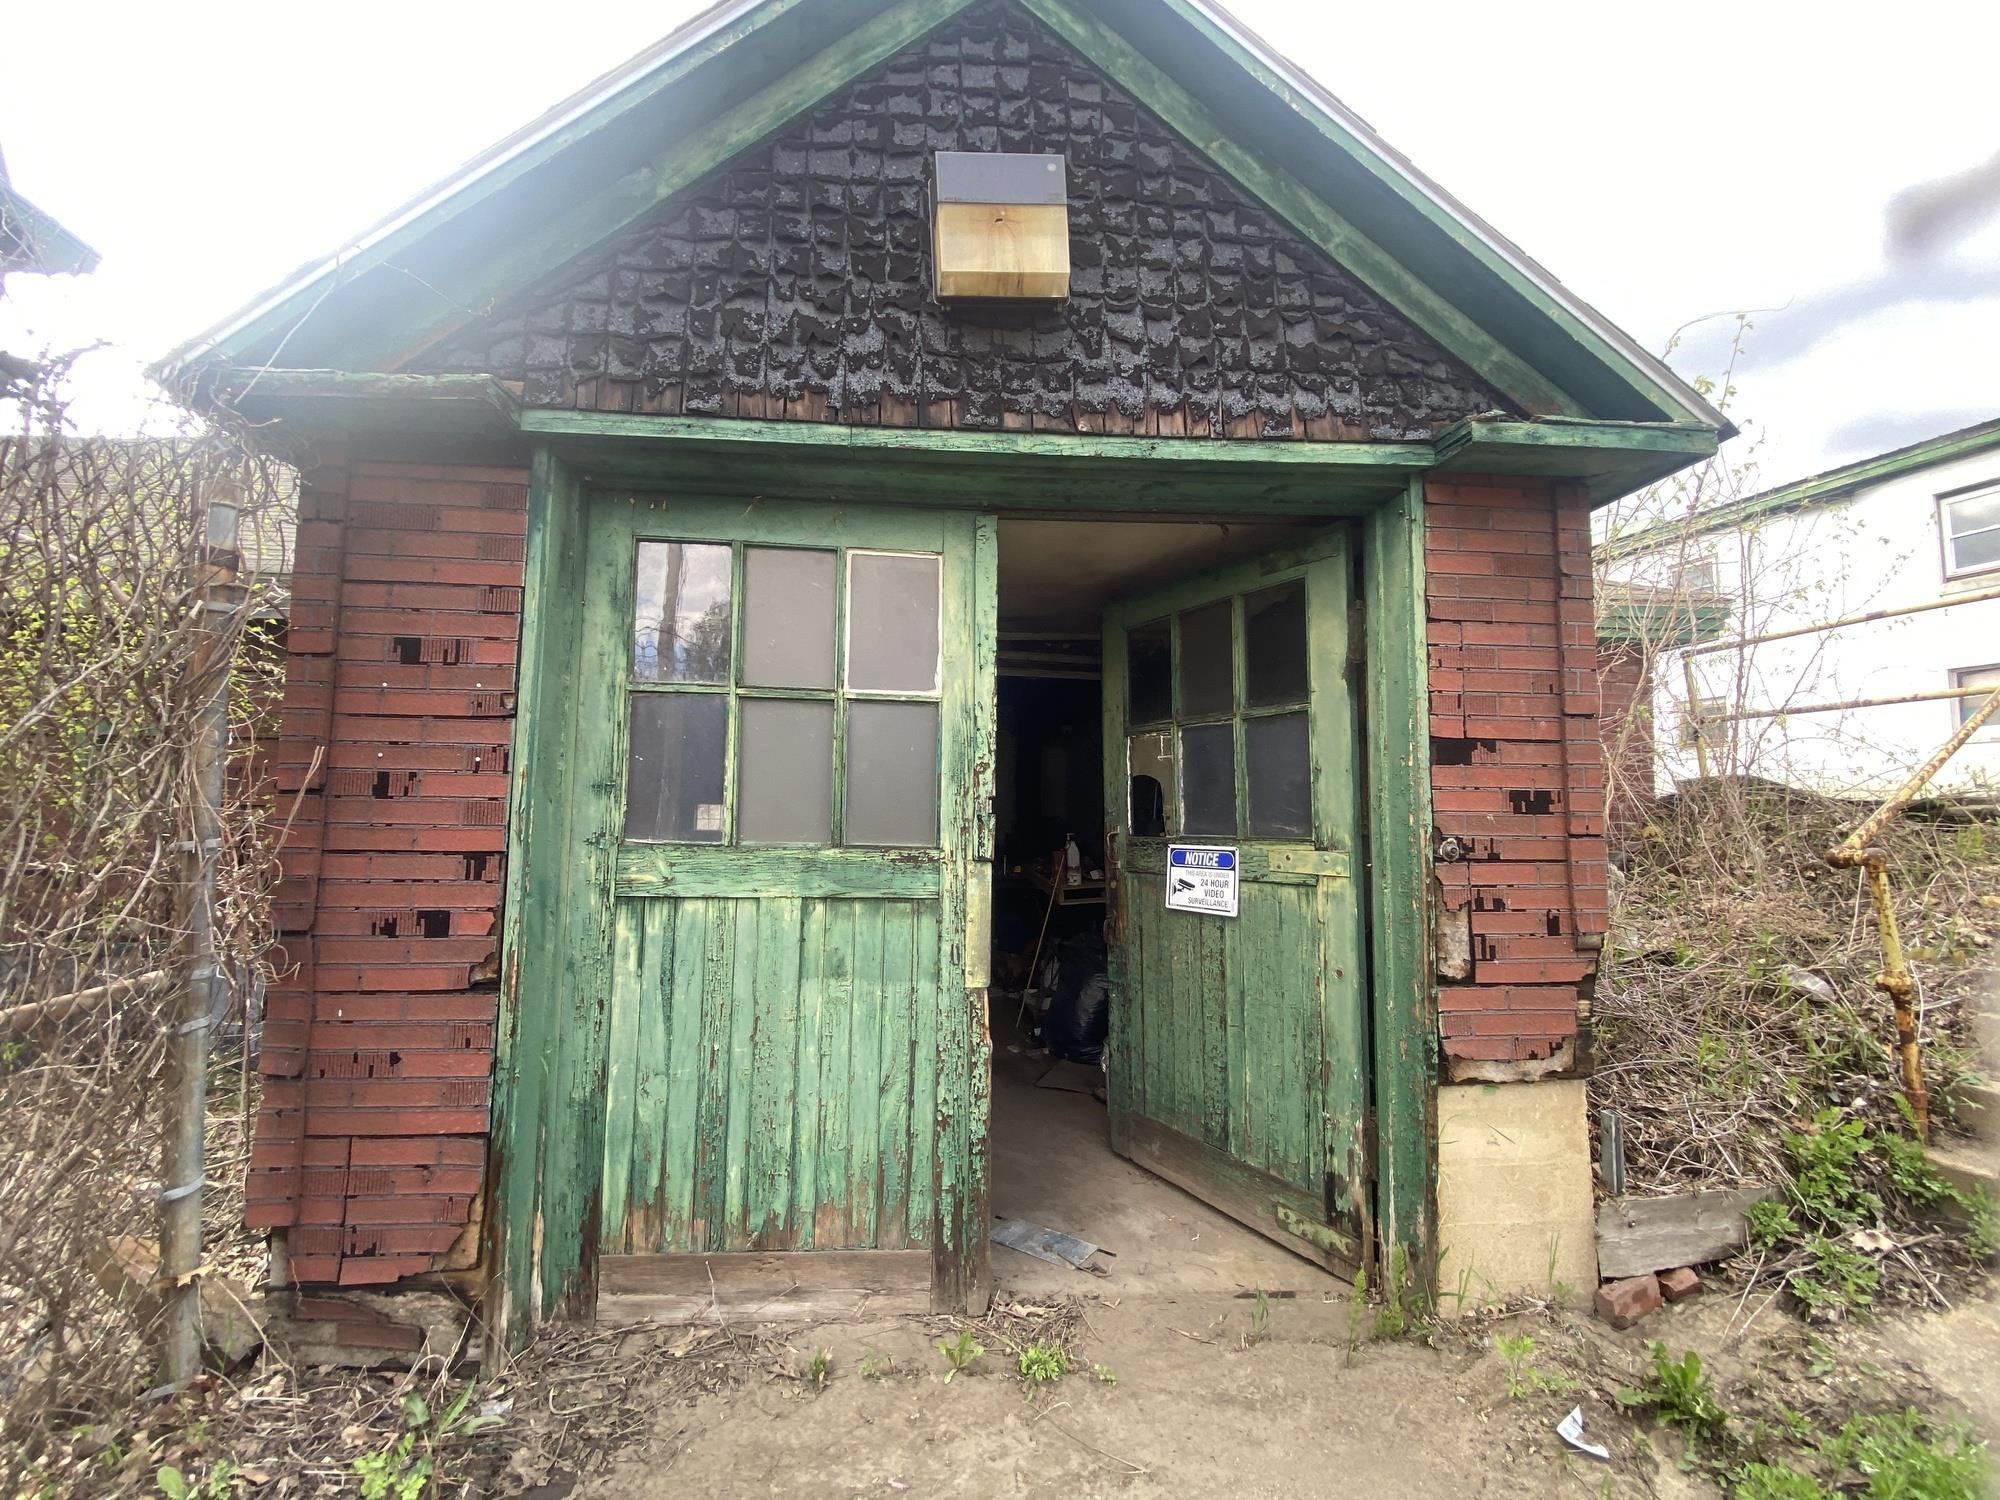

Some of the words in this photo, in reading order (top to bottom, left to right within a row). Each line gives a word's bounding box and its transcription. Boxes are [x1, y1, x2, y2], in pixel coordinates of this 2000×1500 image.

[1185, 852, 1219, 866] NOTICE
[1200, 879, 1208, 887] 24
[1210, 879, 1229, 888] HOUR
[1204, 889, 1224, 898] VIDEO
[1188, 897, 1228, 908] SURVEILLANCE
